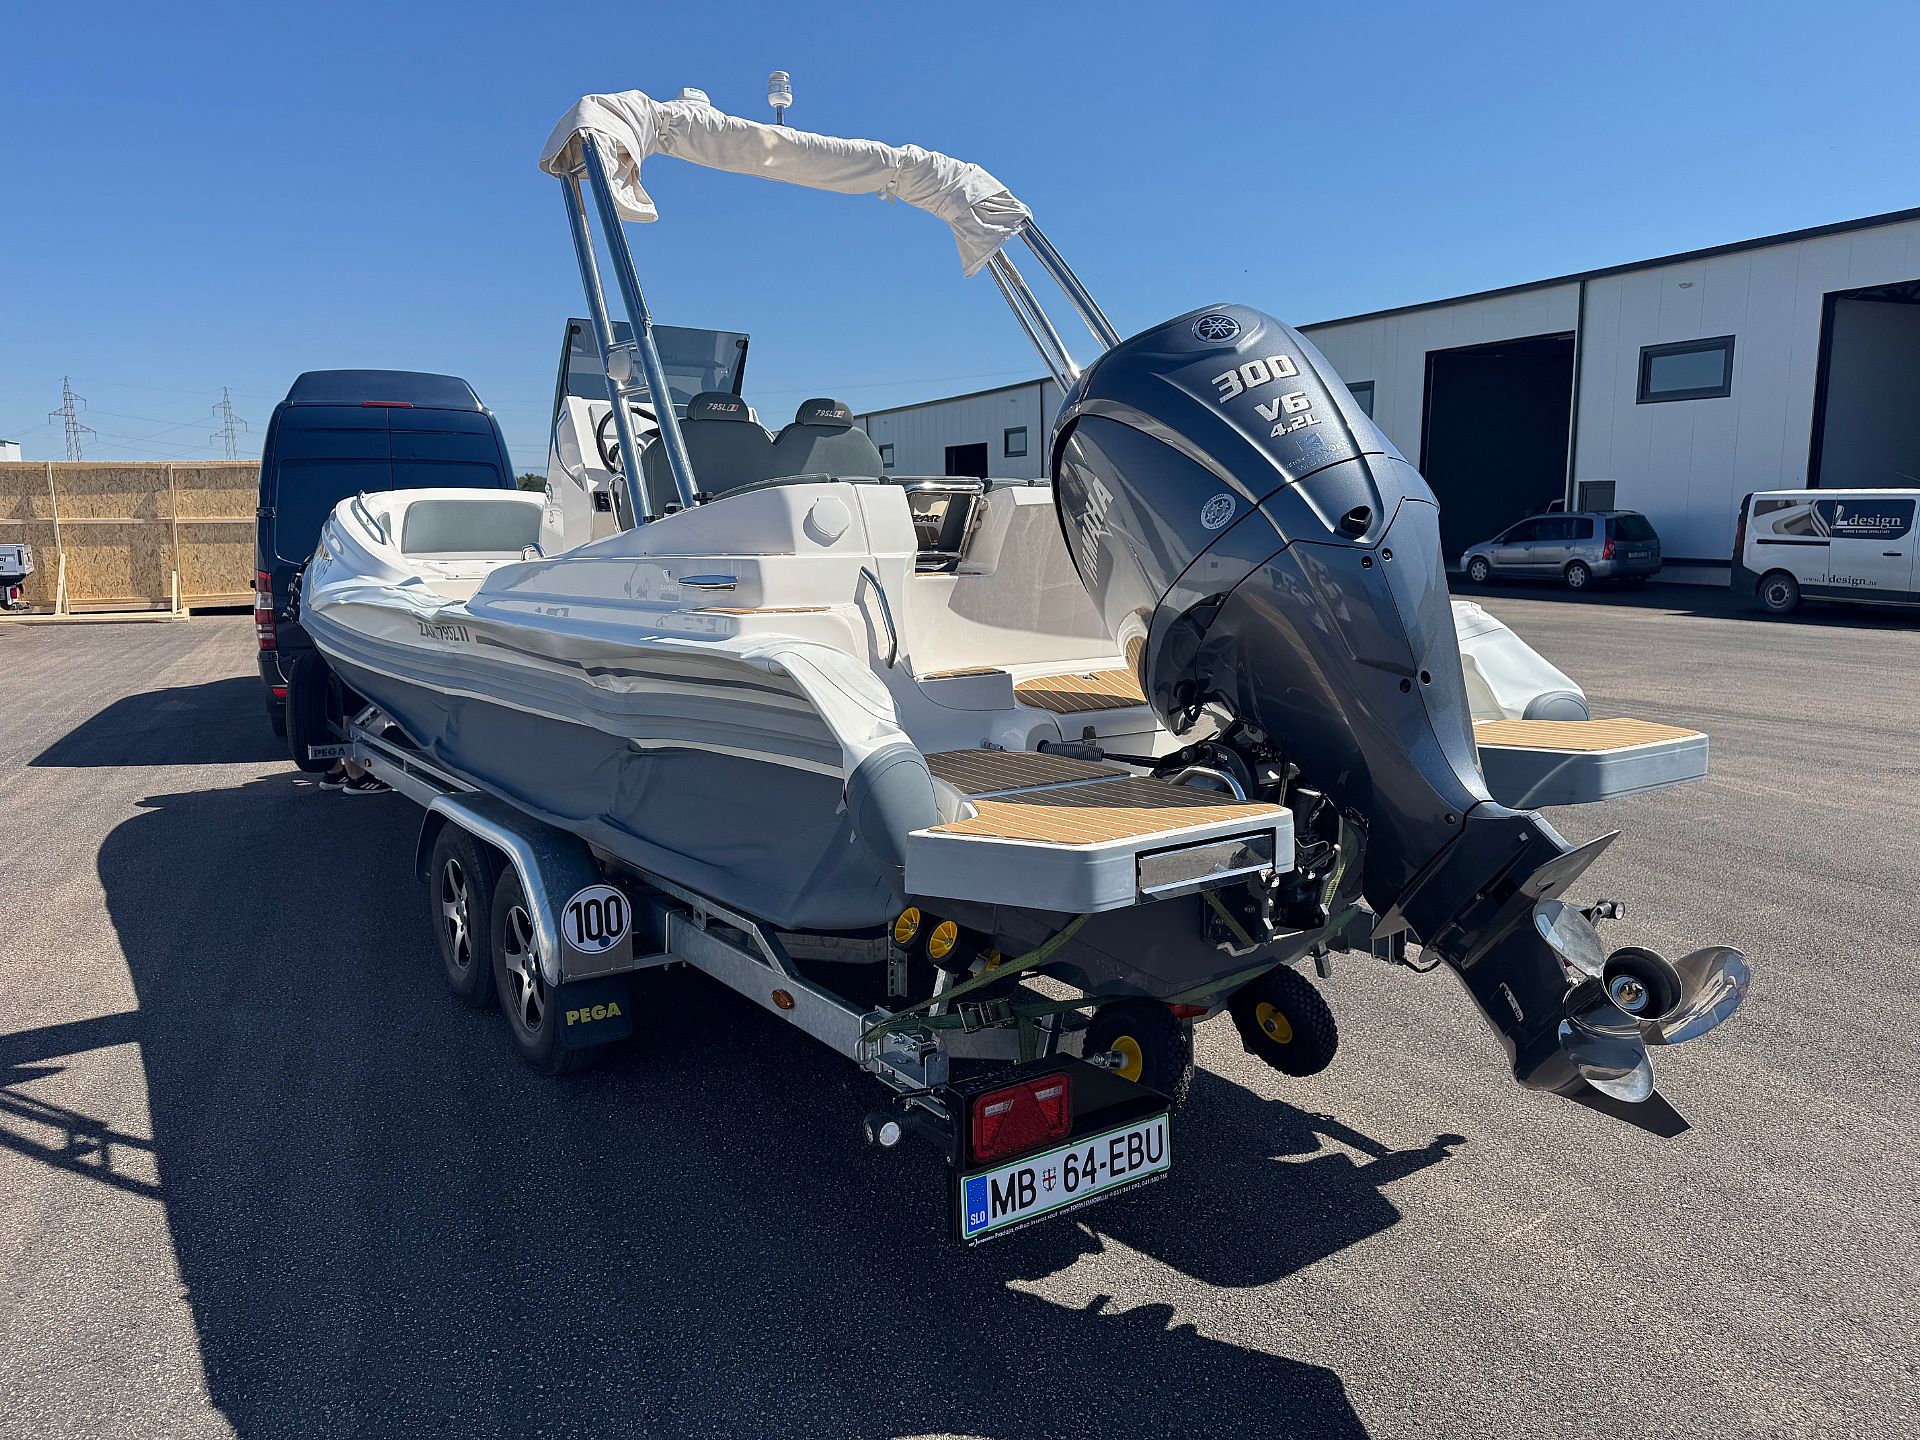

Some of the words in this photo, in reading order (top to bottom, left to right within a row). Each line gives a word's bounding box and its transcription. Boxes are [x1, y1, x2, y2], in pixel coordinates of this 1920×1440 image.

[1211, 354, 1300, 405] 300
[1253, 391, 1312, 422] V6
[1270, 413, 1322, 438] 4.2L
[1081, 476, 1114, 588] YAMAHA
[313, 747, 346, 758] PEGA
[568, 895, 624, 944] 100
[565, 1001, 622, 1026] PEGA
[990, 1167, 1037, 1219] MB
[1062, 1124, 1164, 1193] 64-EBU
[970, 1210, 986, 1226] SLO
